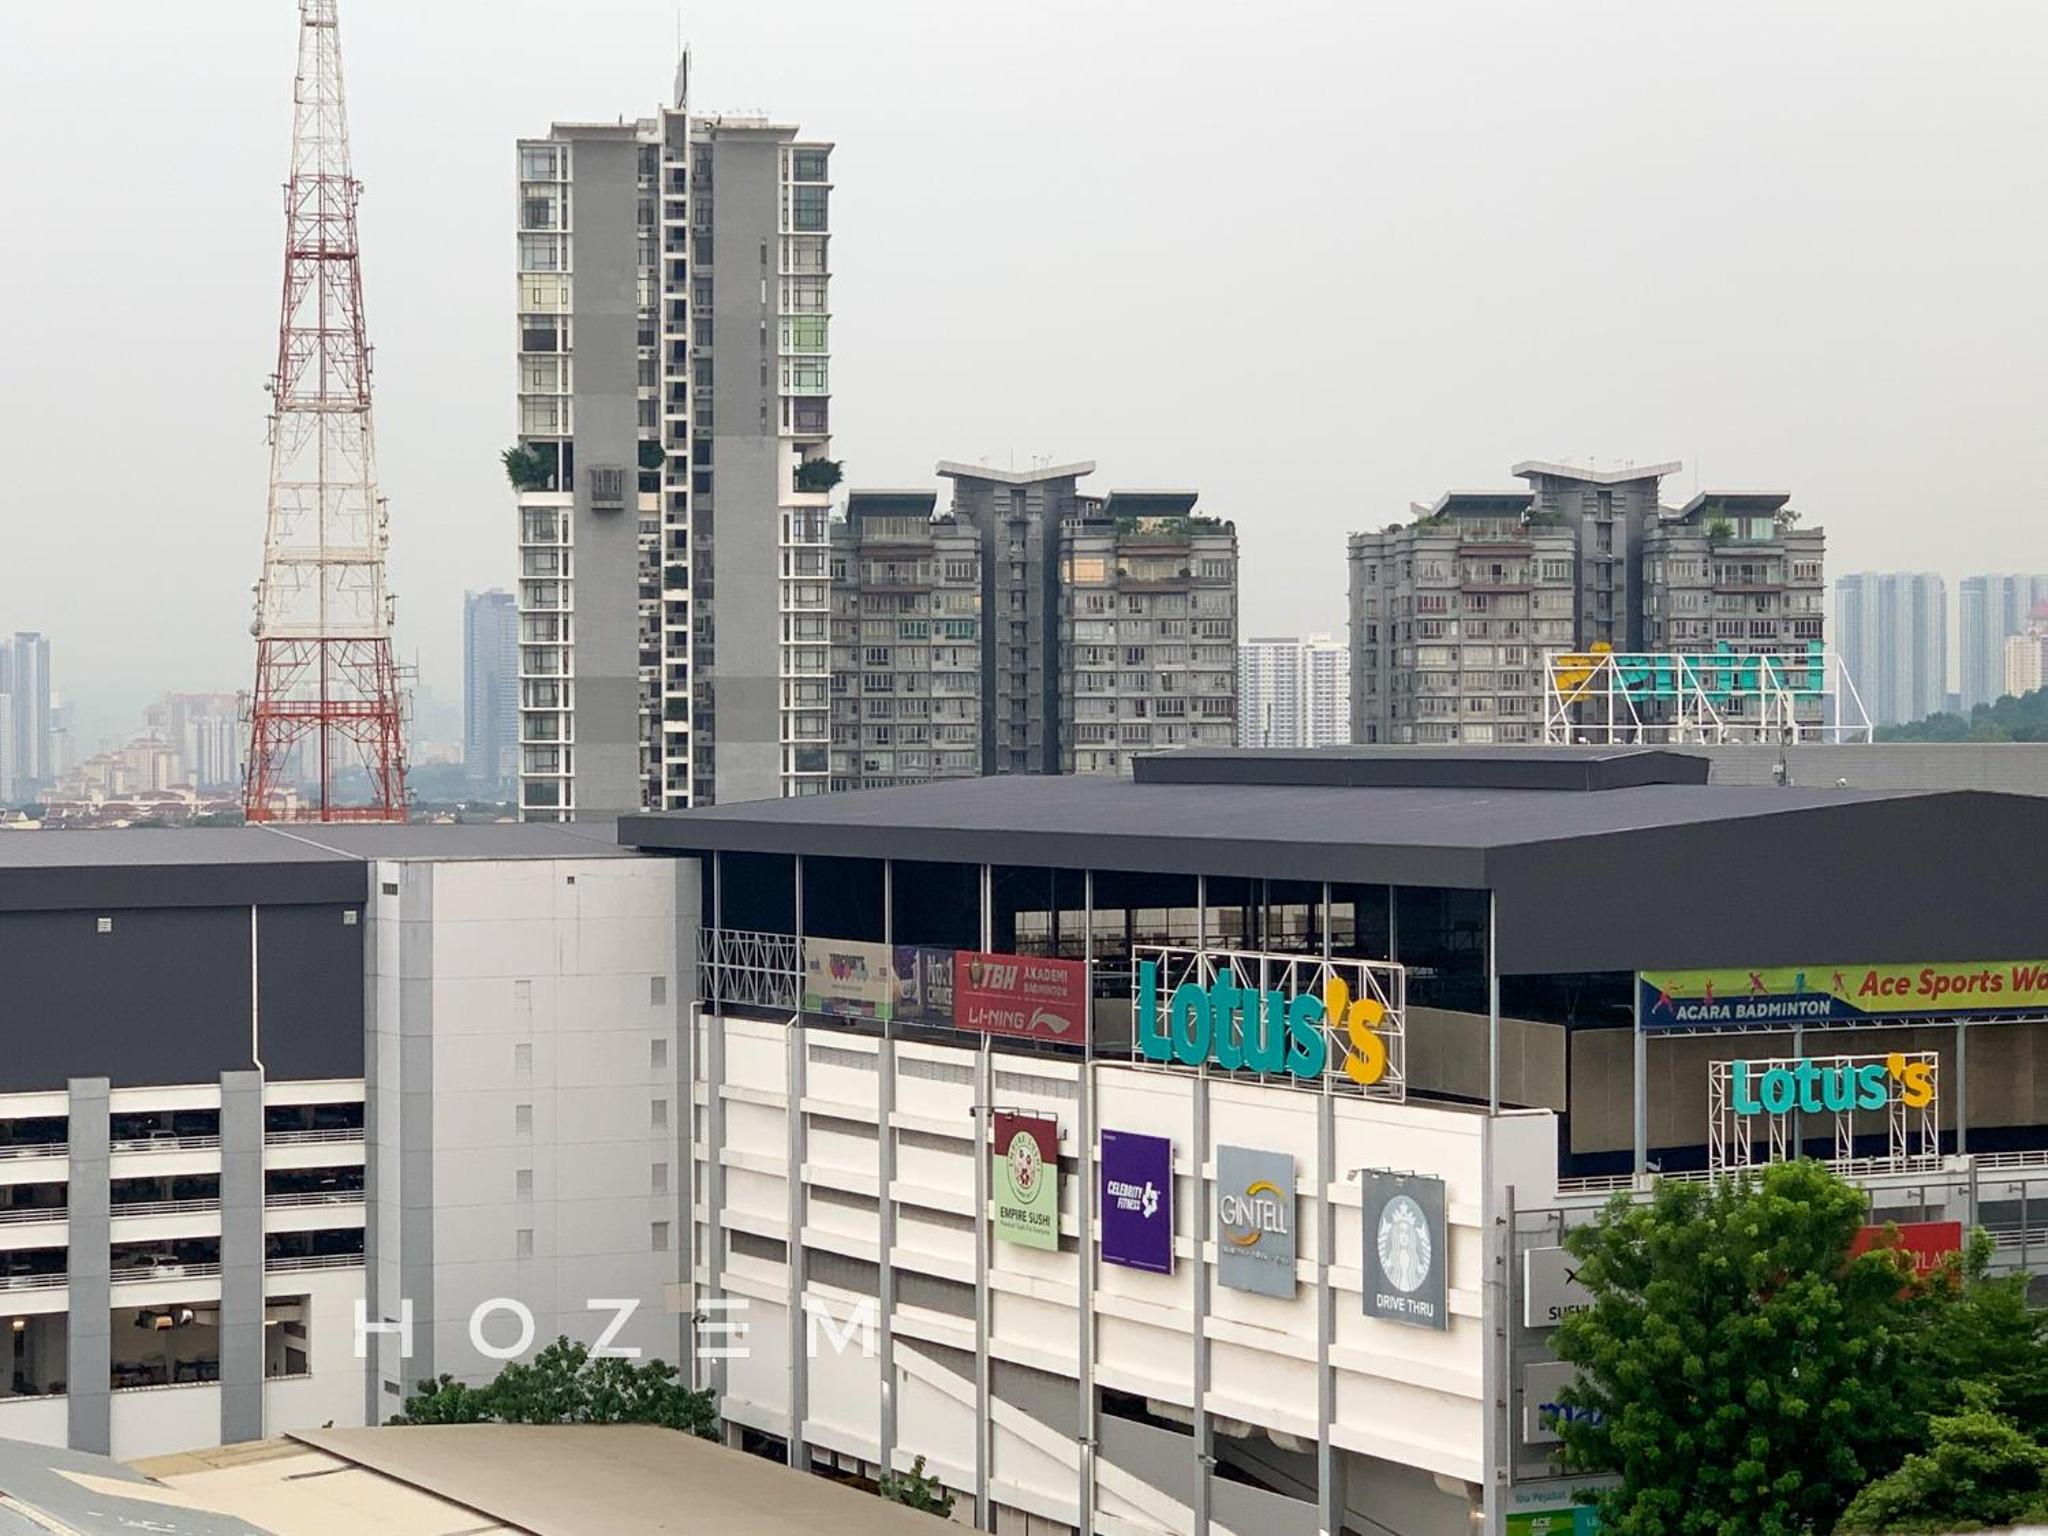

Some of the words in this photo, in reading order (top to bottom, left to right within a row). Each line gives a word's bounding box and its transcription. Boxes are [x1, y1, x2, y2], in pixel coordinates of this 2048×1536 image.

[982, 963, 1018, 991] TBH
[1024, 966, 1068, 984] AKADEMI
[1858, 970, 1911, 997] Ace
[1916, 968, 2004, 1001] Sports
[926, 987, 953, 1006] CHOICE
[968, 1007, 1025, 1030] LI-NING
[1676, 1004, 1731, 1020] ACARA
[1735, 1000, 1831, 1018] BADMINTON
[1139, 960, 1388, 1085] Lotus's
[1731, 1052, 1934, 1115] Lotus's
[1107, 1180, 1143, 1199] CELEBRITY
[1116, 1196, 1141, 1211] FITNESS
[1220, 1194, 1288, 1234] GINTELL
[1000, 1206, 1027, 1223] EMPIRE
[1028, 1211, 1051, 1227] SUSHI
[1376, 1293, 1406, 1312] DRIVE
[1407, 1299, 1435, 1318] THRU
